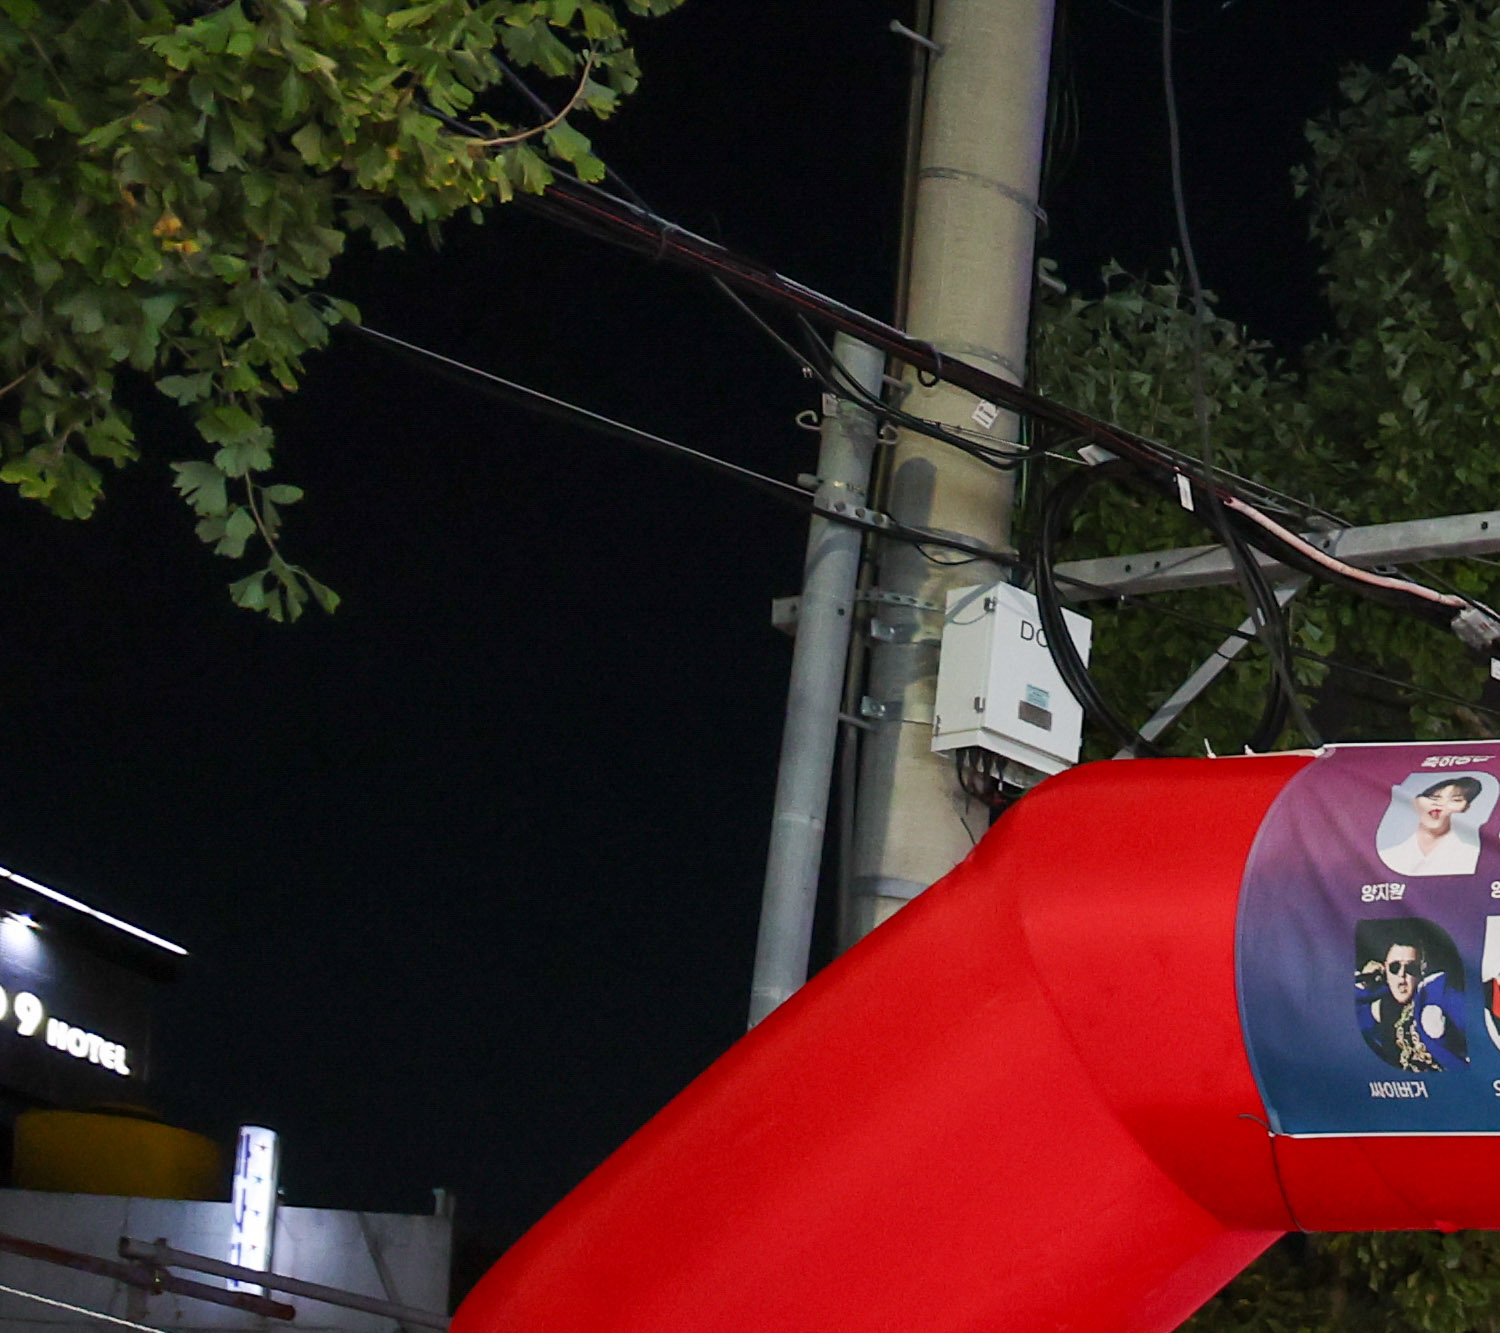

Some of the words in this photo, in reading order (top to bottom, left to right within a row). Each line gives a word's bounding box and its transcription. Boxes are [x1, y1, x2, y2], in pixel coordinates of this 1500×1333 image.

[1361, 883, 1405, 902] 양지원
[0, 986, 43, 1036] 9
[46, 1017, 131, 1076] HOTEL
[1369, 1081, 1428, 1099] 싸이버거
